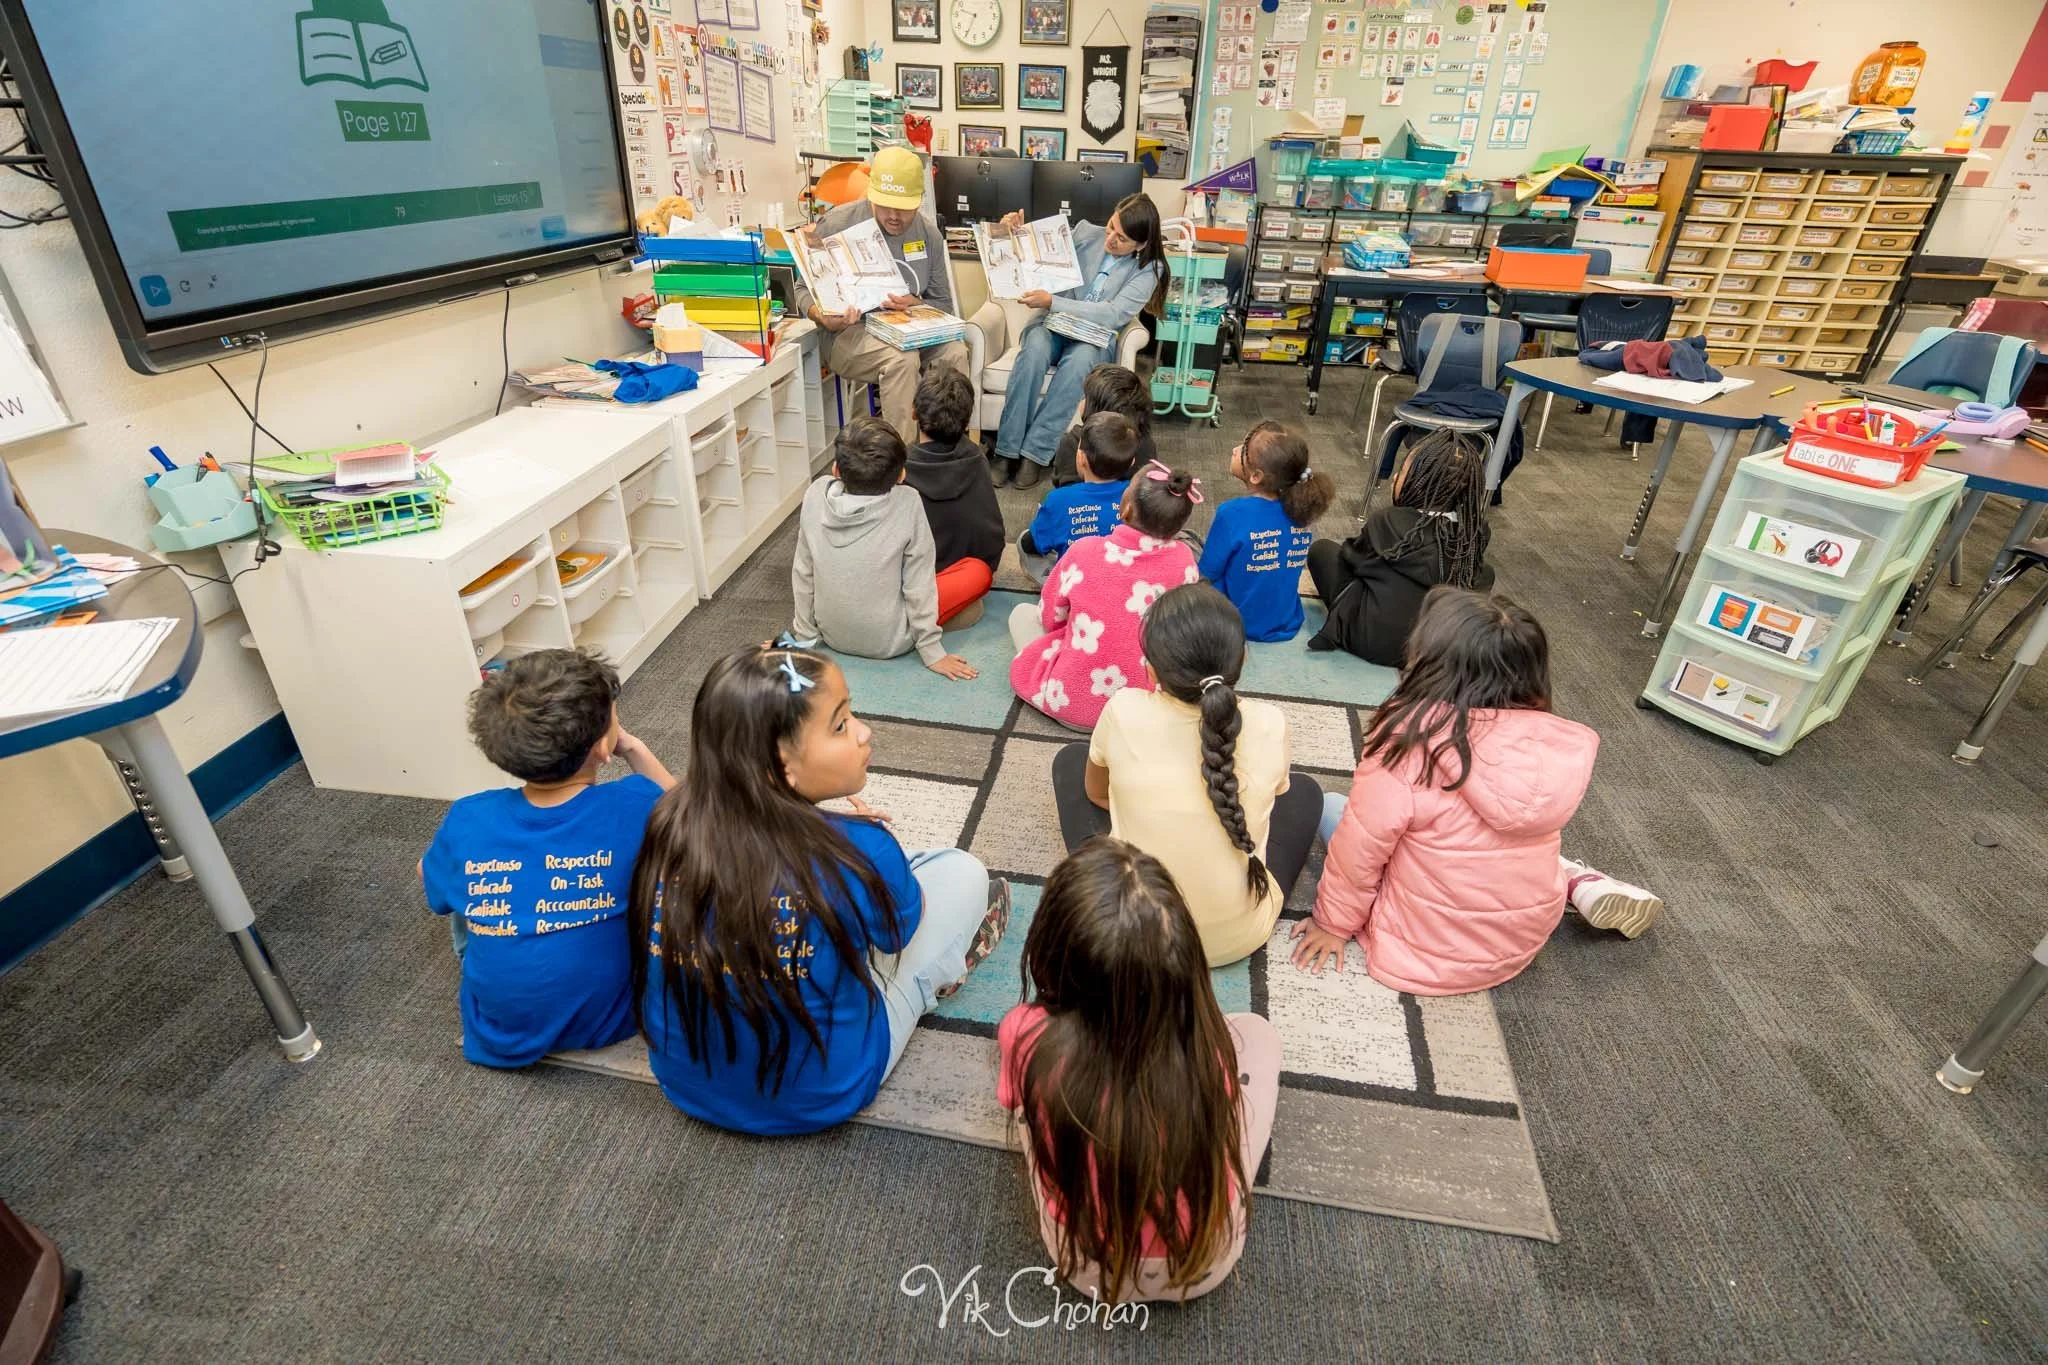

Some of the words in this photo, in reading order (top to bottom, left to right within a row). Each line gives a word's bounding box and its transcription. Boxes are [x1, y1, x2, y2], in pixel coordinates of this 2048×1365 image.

[1092, 66, 1118, 77] WRIGHT
[620, 91, 647, 107] Specials
[343, 110, 390, 138] Page
[393, 111, 417, 133] 127
[881, 174, 893, 183] DO
[1793, 446, 1825, 464] table
[1827, 454, 1860, 473] ONE
[464, 859, 522, 875] Respetuoso
[545, 849, 612, 870] Respectful
[468, 876, 512, 896] Enfocado
[550, 872, 604, 890] On-Task
[464, 899, 512, 917] Confiable
